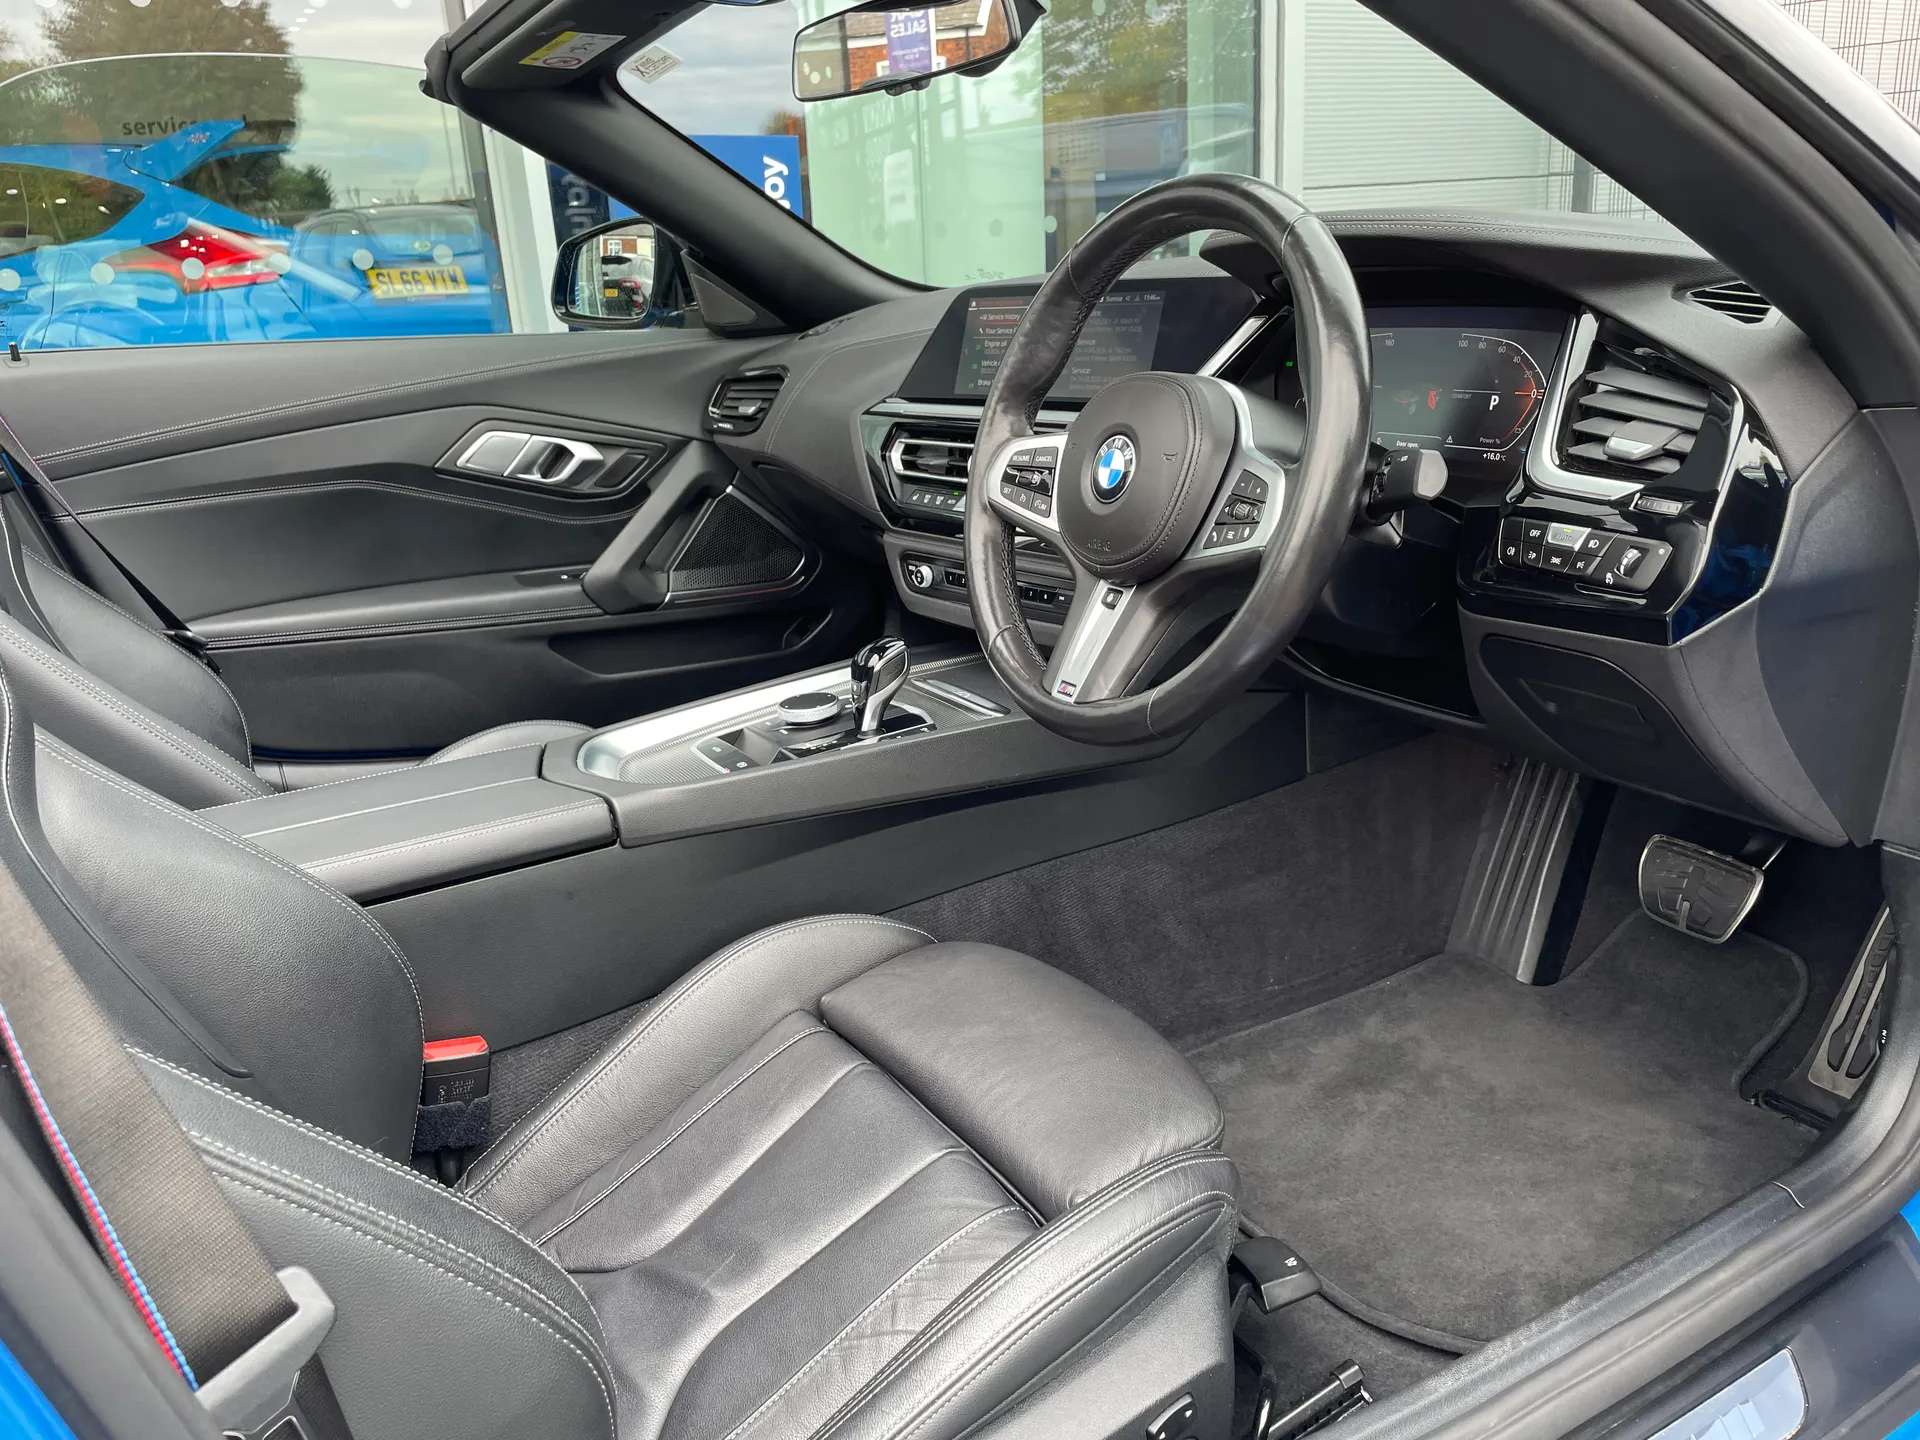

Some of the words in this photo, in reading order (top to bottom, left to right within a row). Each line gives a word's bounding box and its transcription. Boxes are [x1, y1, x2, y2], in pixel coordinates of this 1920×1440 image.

[1458, 340, 1469, 348] 100
[1497, 345, 1507, 354] 60
[1512, 355, 1521, 364] 40
[1524, 370, 1533, 378] 20
[1530, 388, 1537, 398] 0
[1489, 395, 1500, 411] P
[1529, 529, 1541, 538] OFF
